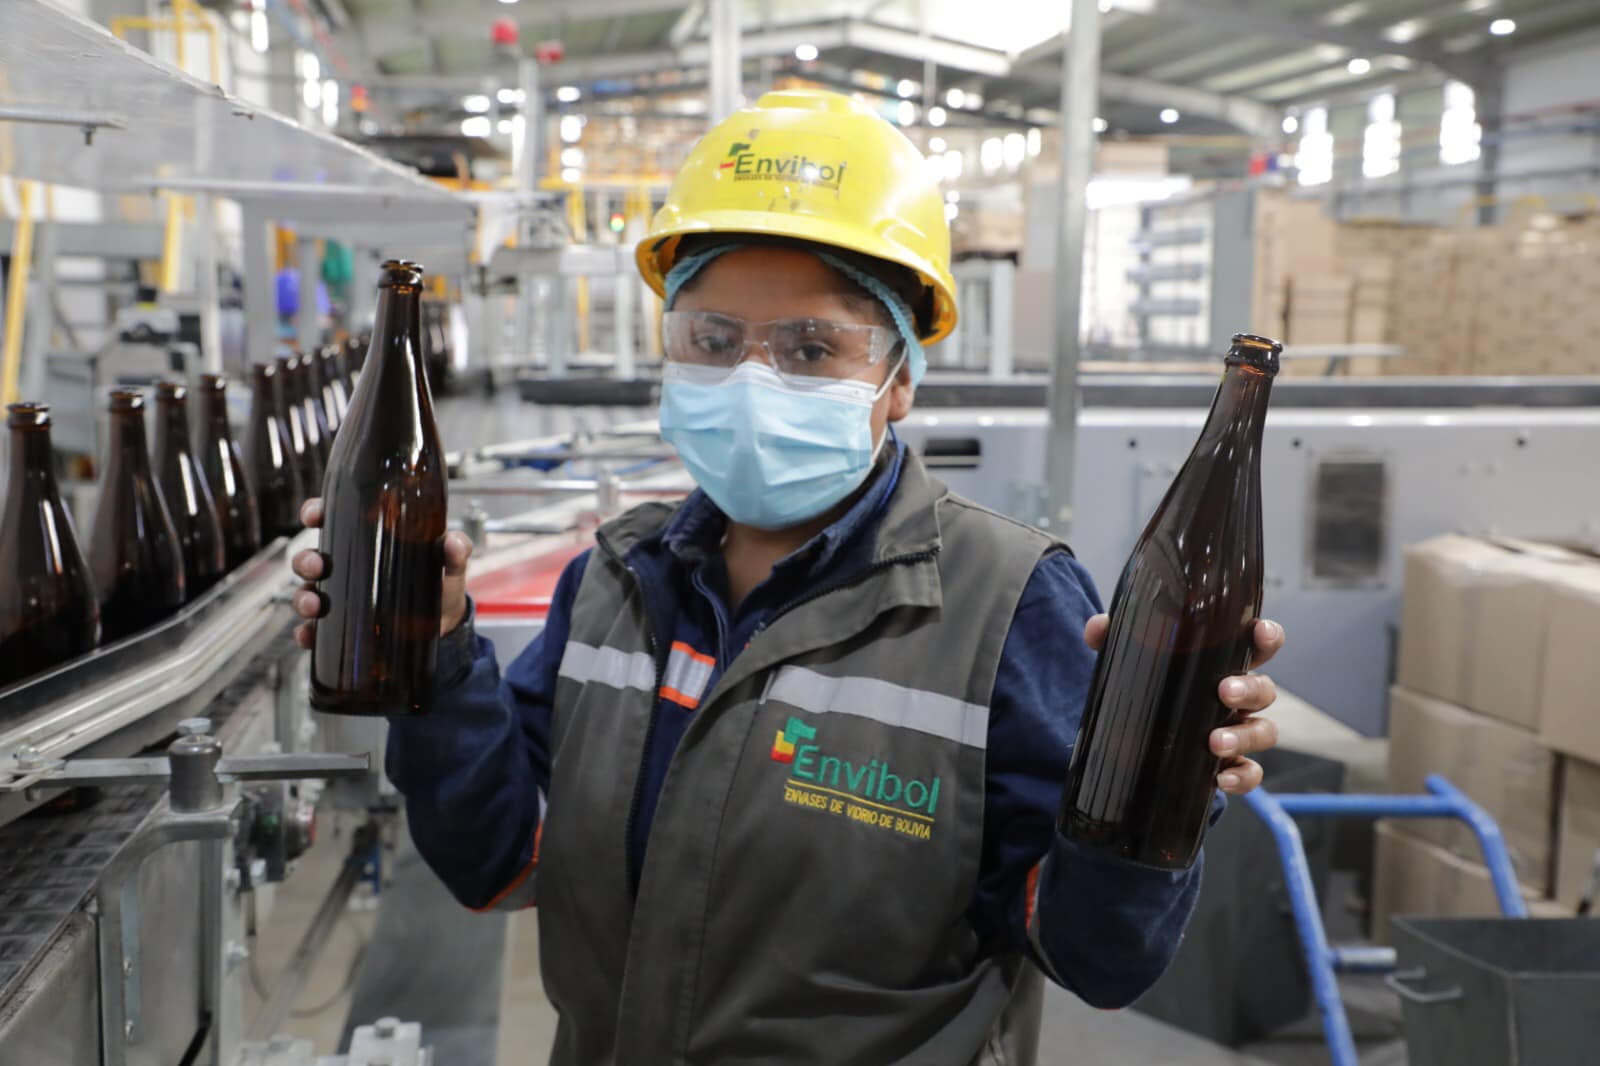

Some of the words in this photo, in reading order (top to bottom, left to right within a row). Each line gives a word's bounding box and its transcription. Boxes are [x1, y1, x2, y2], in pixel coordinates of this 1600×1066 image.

[792, 745, 941, 813] Envibol
[784, 787, 828, 809] ENVASES
[829, 798, 845, 814] DE
[847, 803, 878, 824] VIDRIO
[879, 813, 894, 828] DE
[895, 817, 931, 840] BOLIVIA
